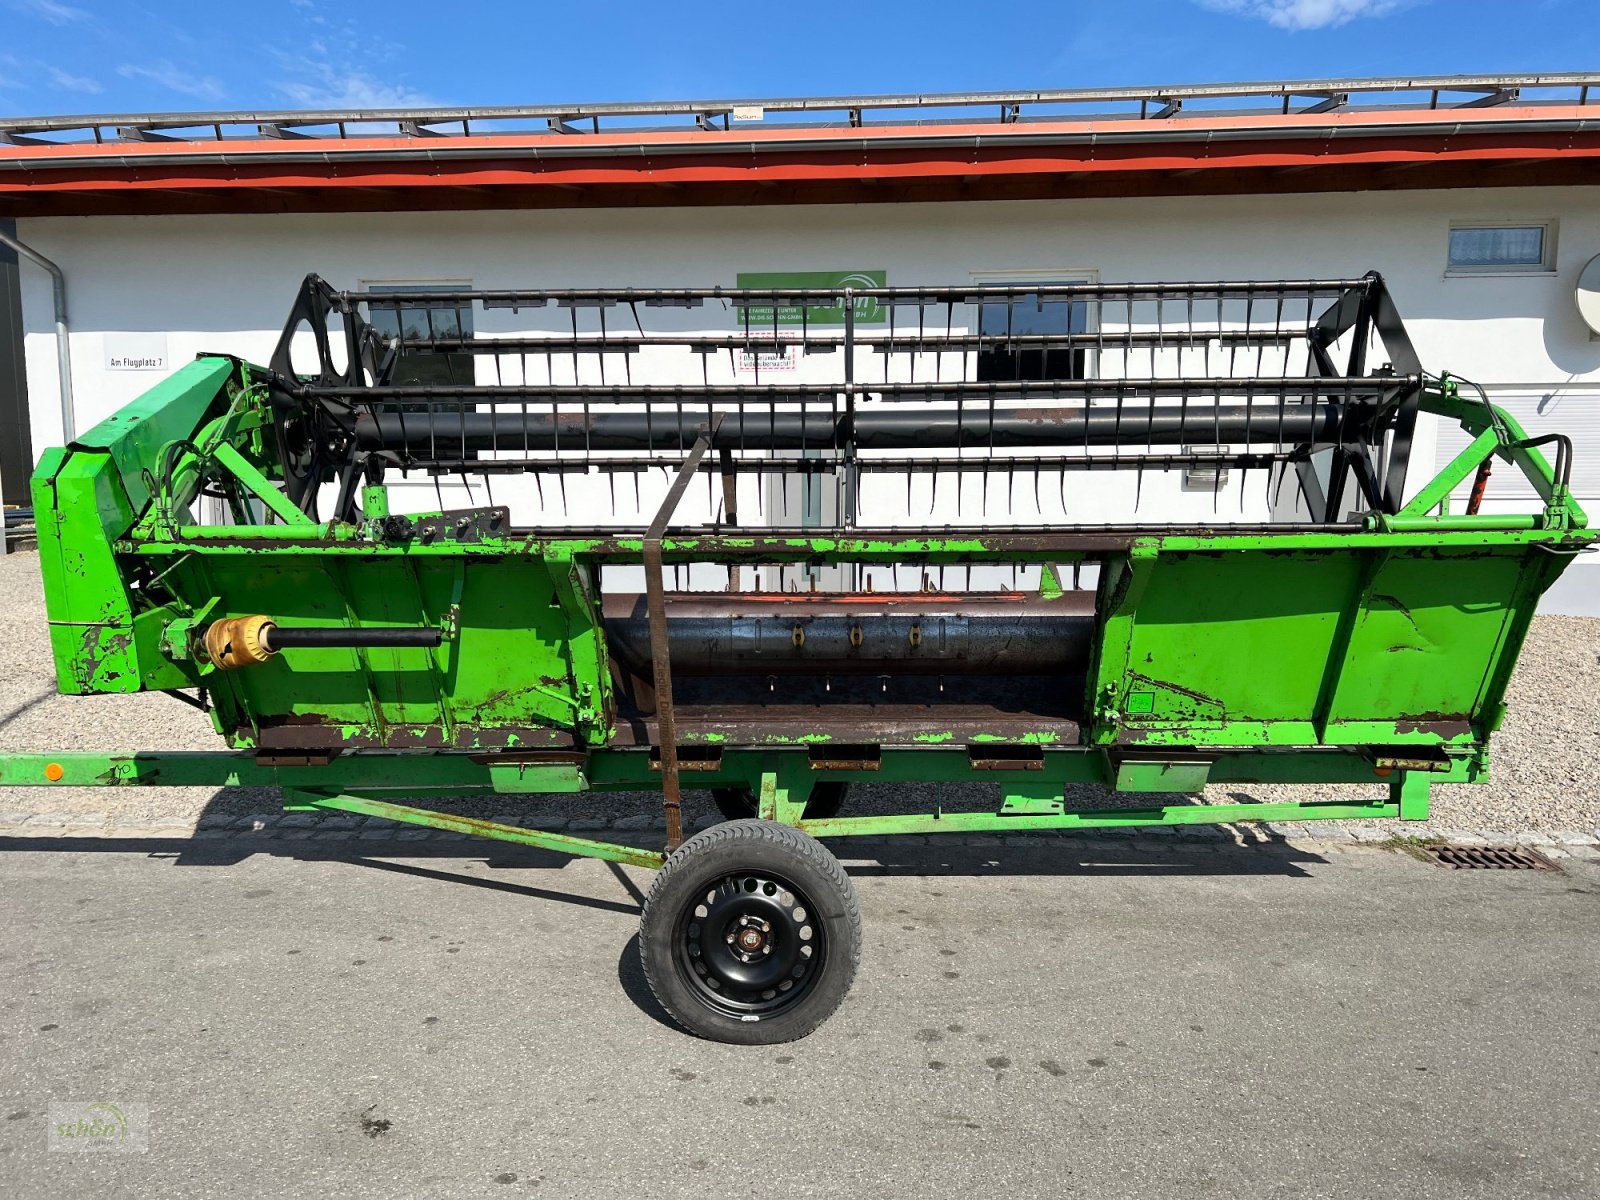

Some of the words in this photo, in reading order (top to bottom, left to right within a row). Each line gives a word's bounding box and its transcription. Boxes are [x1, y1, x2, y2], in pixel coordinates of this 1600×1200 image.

[110, 357, 121, 366] Am
[123, 357, 156, 368] Flugplatz
[158, 357, 162, 366] 7
